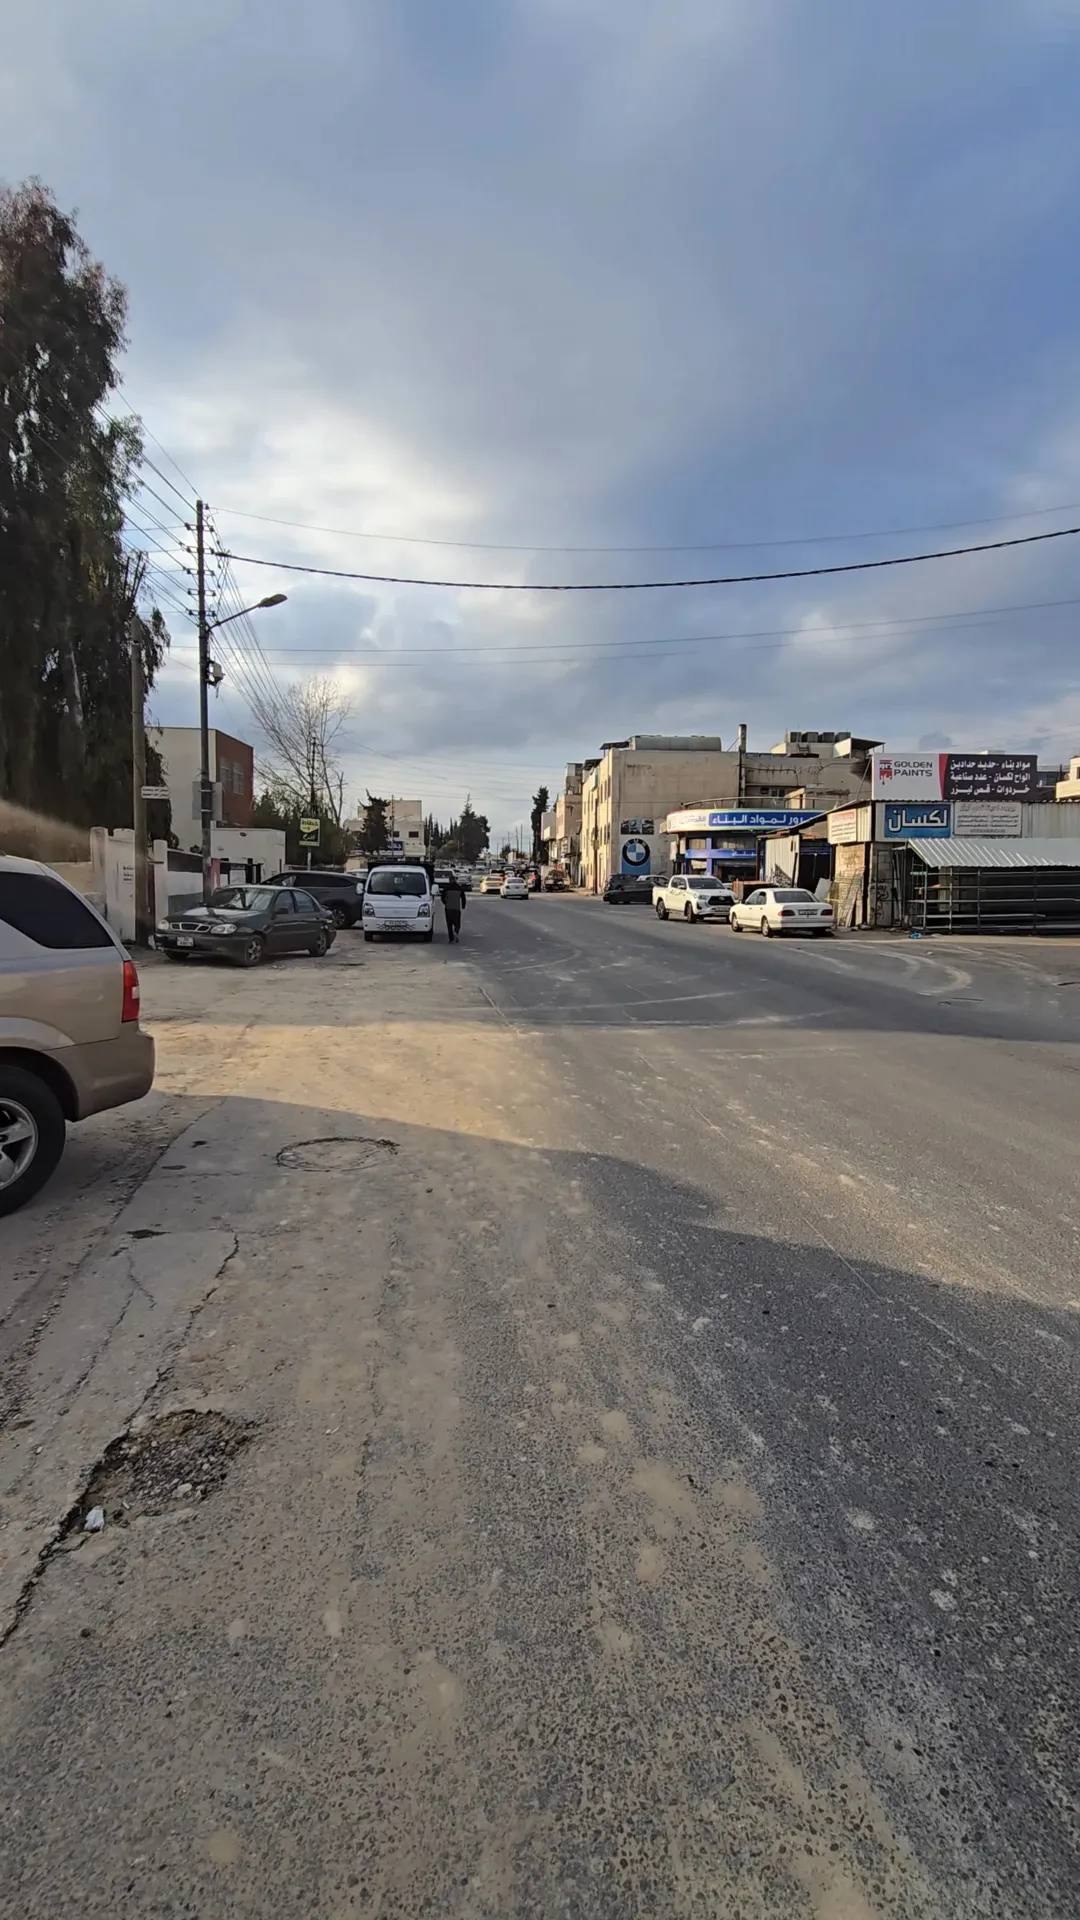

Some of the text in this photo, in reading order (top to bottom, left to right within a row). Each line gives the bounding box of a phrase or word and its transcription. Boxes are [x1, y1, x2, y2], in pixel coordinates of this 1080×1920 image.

[950, 760, 976, 770] حدادين
[1001, 760, 1015, 771] بناء
[1015, 760, 1031, 770] مواد
[894, 769, 933, 777] PAINTS
[950, 772, 973, 783] صناعية
[993, 772, 1014, 783] لكسان
[1014, 772, 1031, 783] الواح
[950, 784, 973, 796] ليزر
[973, 784, 991, 796] قص
[996, 784, 1031, 796] خردوات
[712, 814, 747, 826] البناء
[750, 814, 786, 825] لمواد
[888, 809, 948, 832] لكسان
